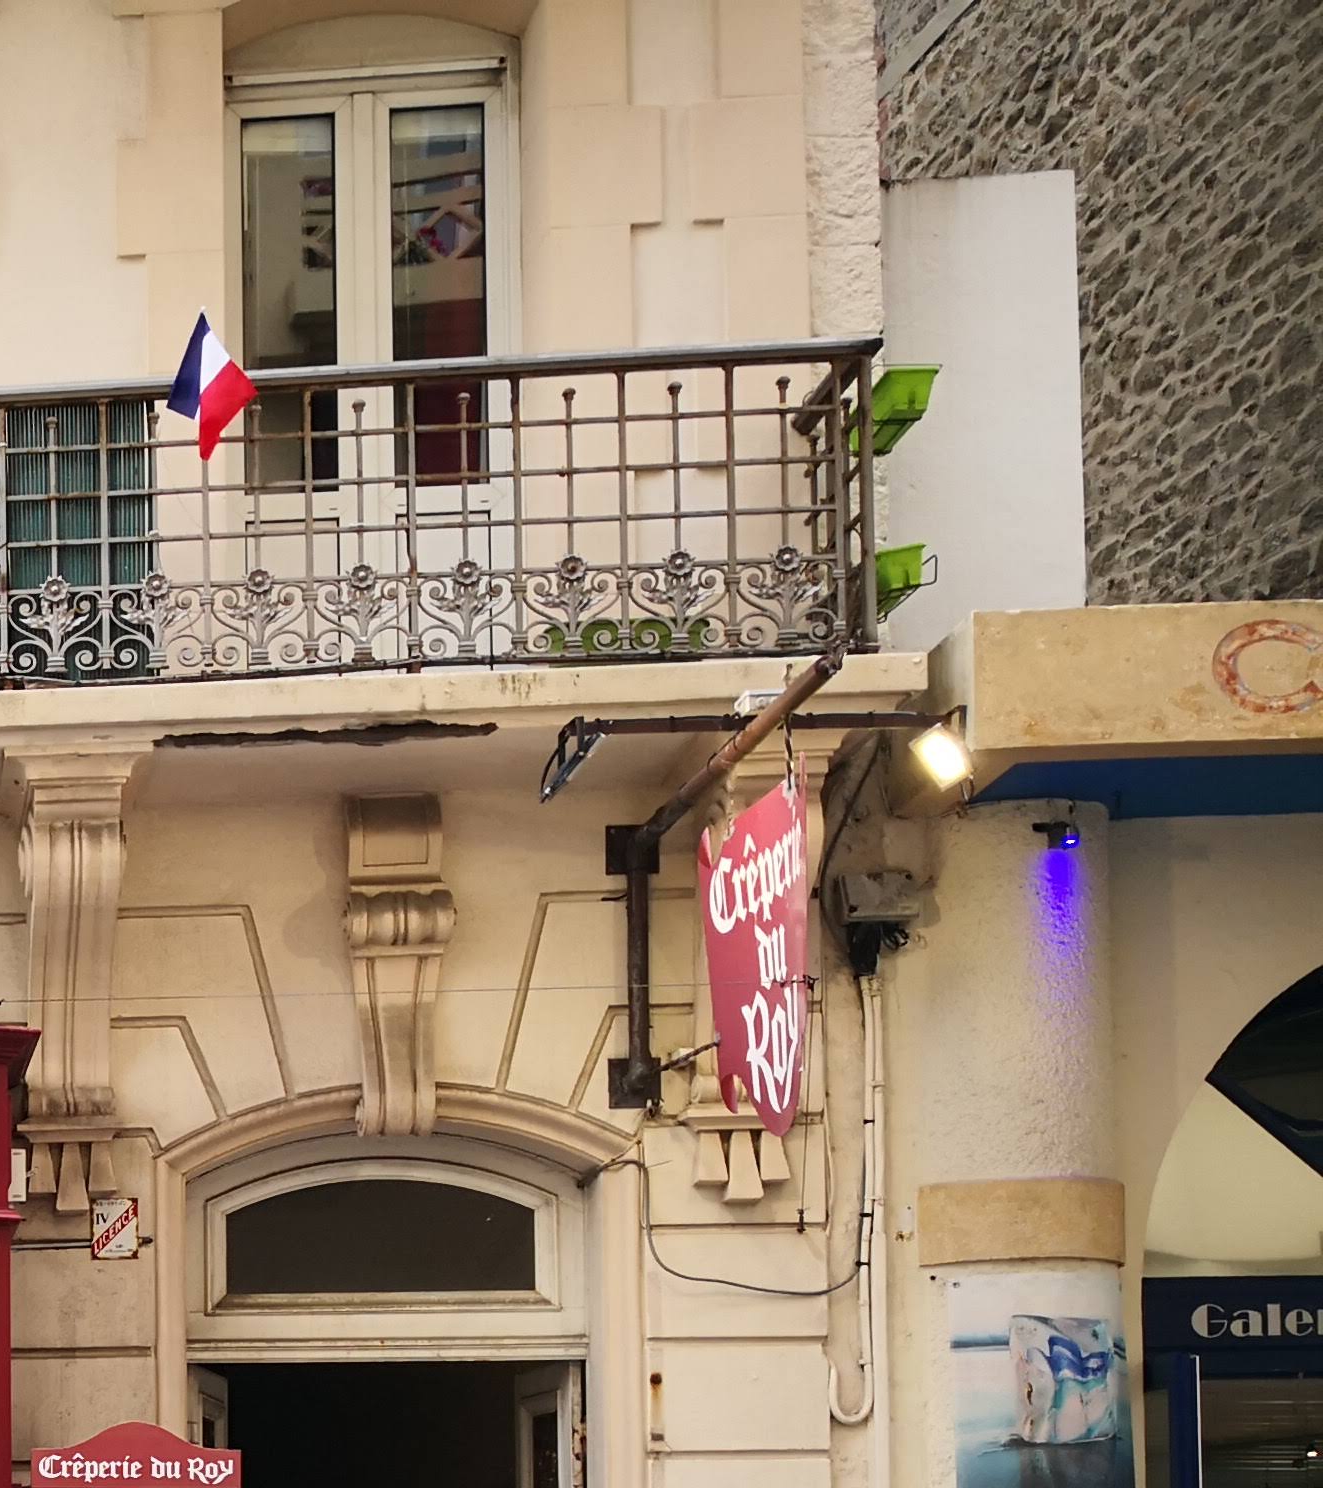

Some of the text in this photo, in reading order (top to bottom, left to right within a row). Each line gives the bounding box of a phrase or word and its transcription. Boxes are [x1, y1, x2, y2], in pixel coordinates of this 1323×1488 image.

[755, 923, 788, 989] du
[741, 975, 799, 1114] Roy
[94, 1205, 135, 1254] LICENCE
[96, 1213, 109, 1224] IV
[39, 1453, 234, 1484] Crêperie du Roy
